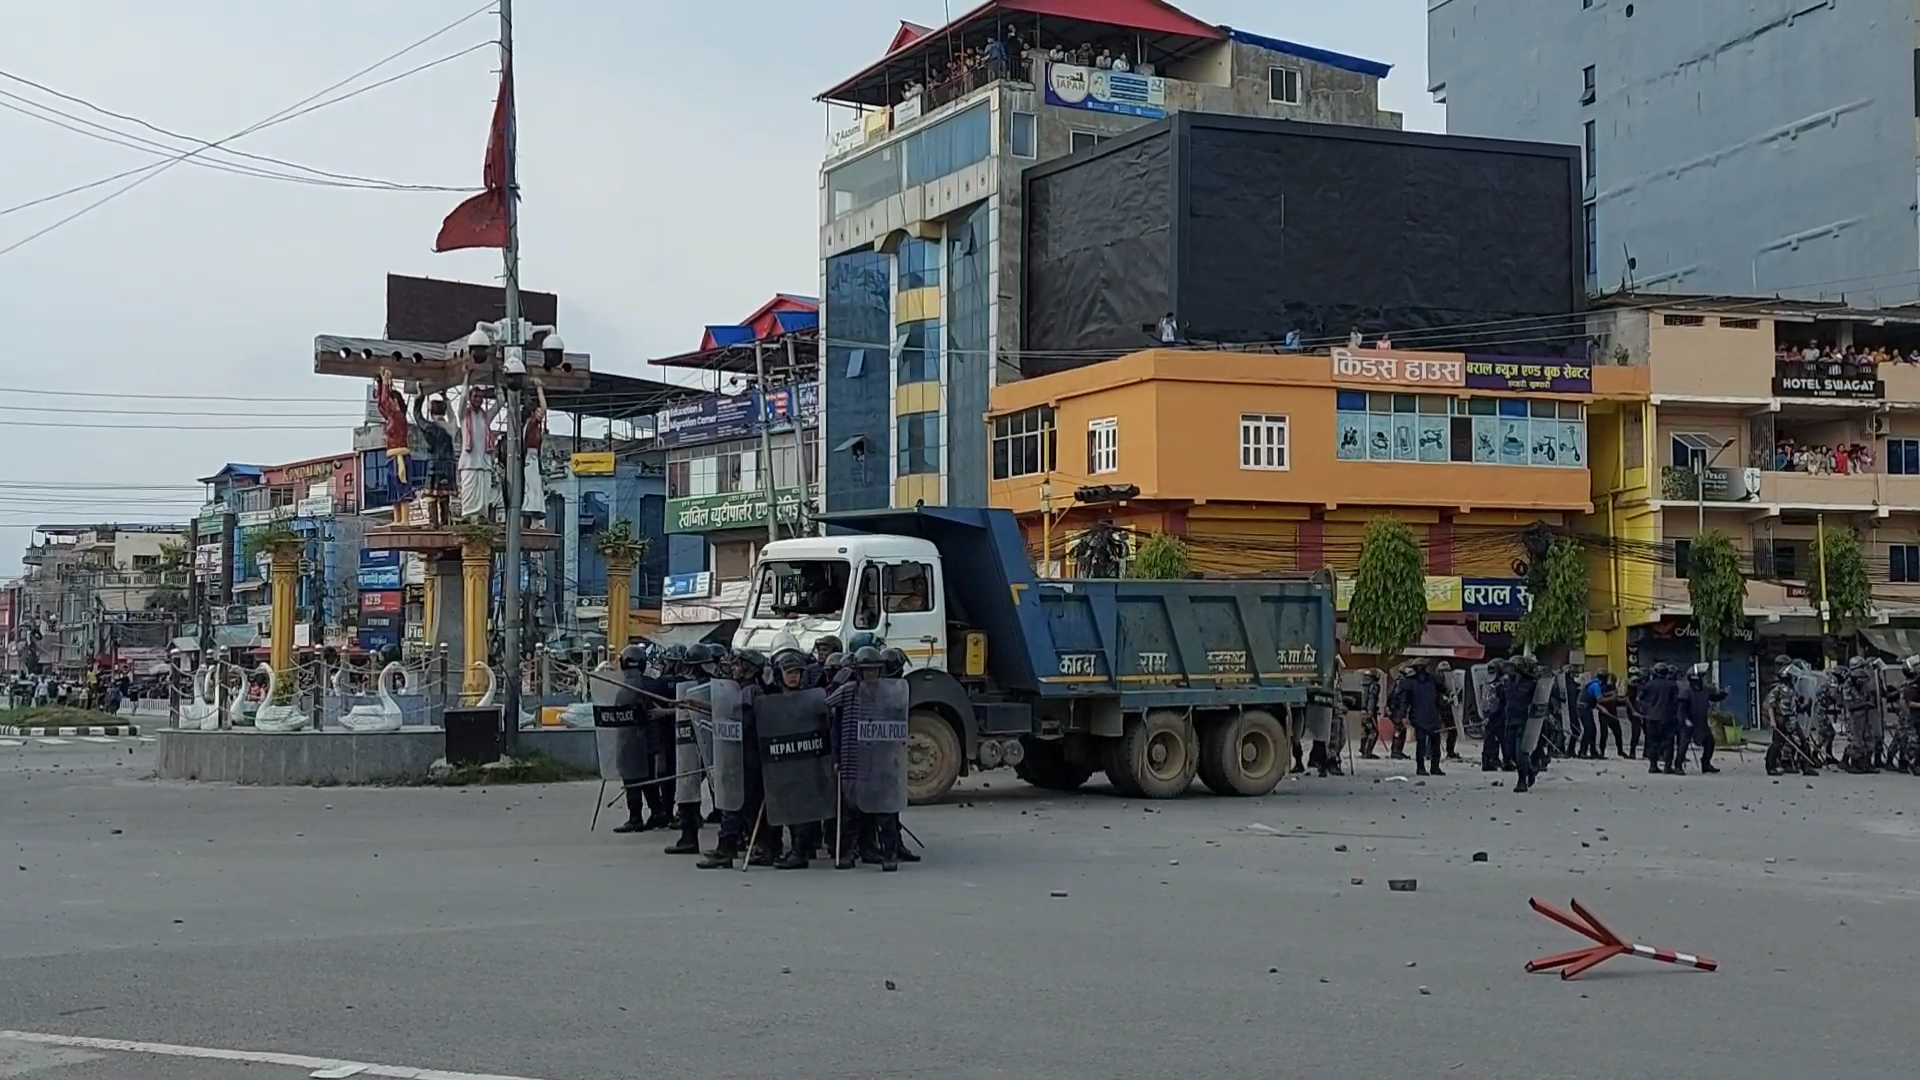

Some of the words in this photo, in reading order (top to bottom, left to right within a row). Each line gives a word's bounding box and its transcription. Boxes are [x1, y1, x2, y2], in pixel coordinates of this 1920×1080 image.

[1056, 79, 1085, 91] JAPAN
[1333, 349, 1398, 381] किड्स
[1404, 359, 1462, 382] हाउस
[1466, 362, 1493, 375] बराल
[1521, 366, 1542, 377] एण्ड
[1544, 366, 1561, 380] बुक
[1783, 378, 1821, 390] HOTEL
[1824, 379, 1875, 391] SWAGAT
[670, 405, 698, 417] Education
[670, 418, 697, 431] Migration
[697, 415, 717, 425] Corner
[1464, 585, 1512, 606] बराल
[1479, 621, 1501, 633] बराल
[601, 711, 616, 722] NEPAL
[616, 710, 634, 721] POLICE
[718, 723, 741, 739] POLICE
[859, 723, 887, 739] NEPAL
[769, 741, 796, 755] NEPAL
[797, 738, 823, 752] POLICE
